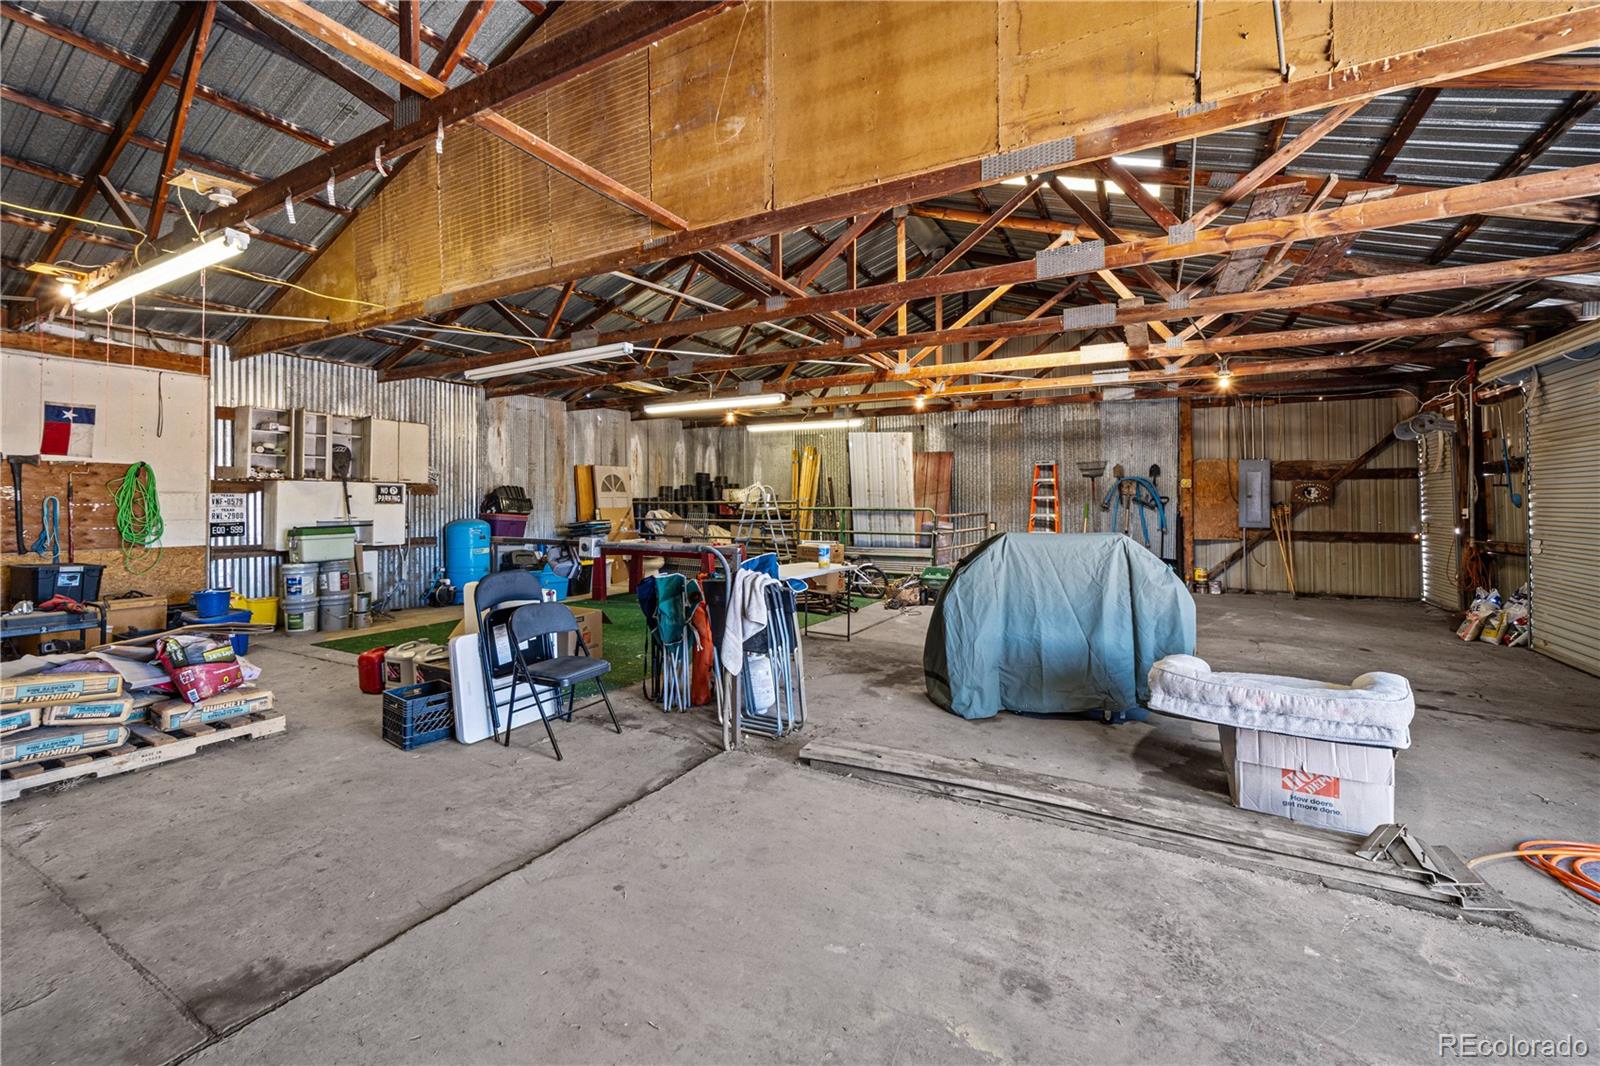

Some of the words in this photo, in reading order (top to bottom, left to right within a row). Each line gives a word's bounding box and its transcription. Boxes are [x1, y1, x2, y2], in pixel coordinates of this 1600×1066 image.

[21, 691, 80, 704] QUIKRETE
[203, 699, 247, 712] QUIKRETE
[20, 746, 80, 761] QUIKRETE
[1290, 794, 1309, 803] How
[1297, 803, 1318, 811] more
